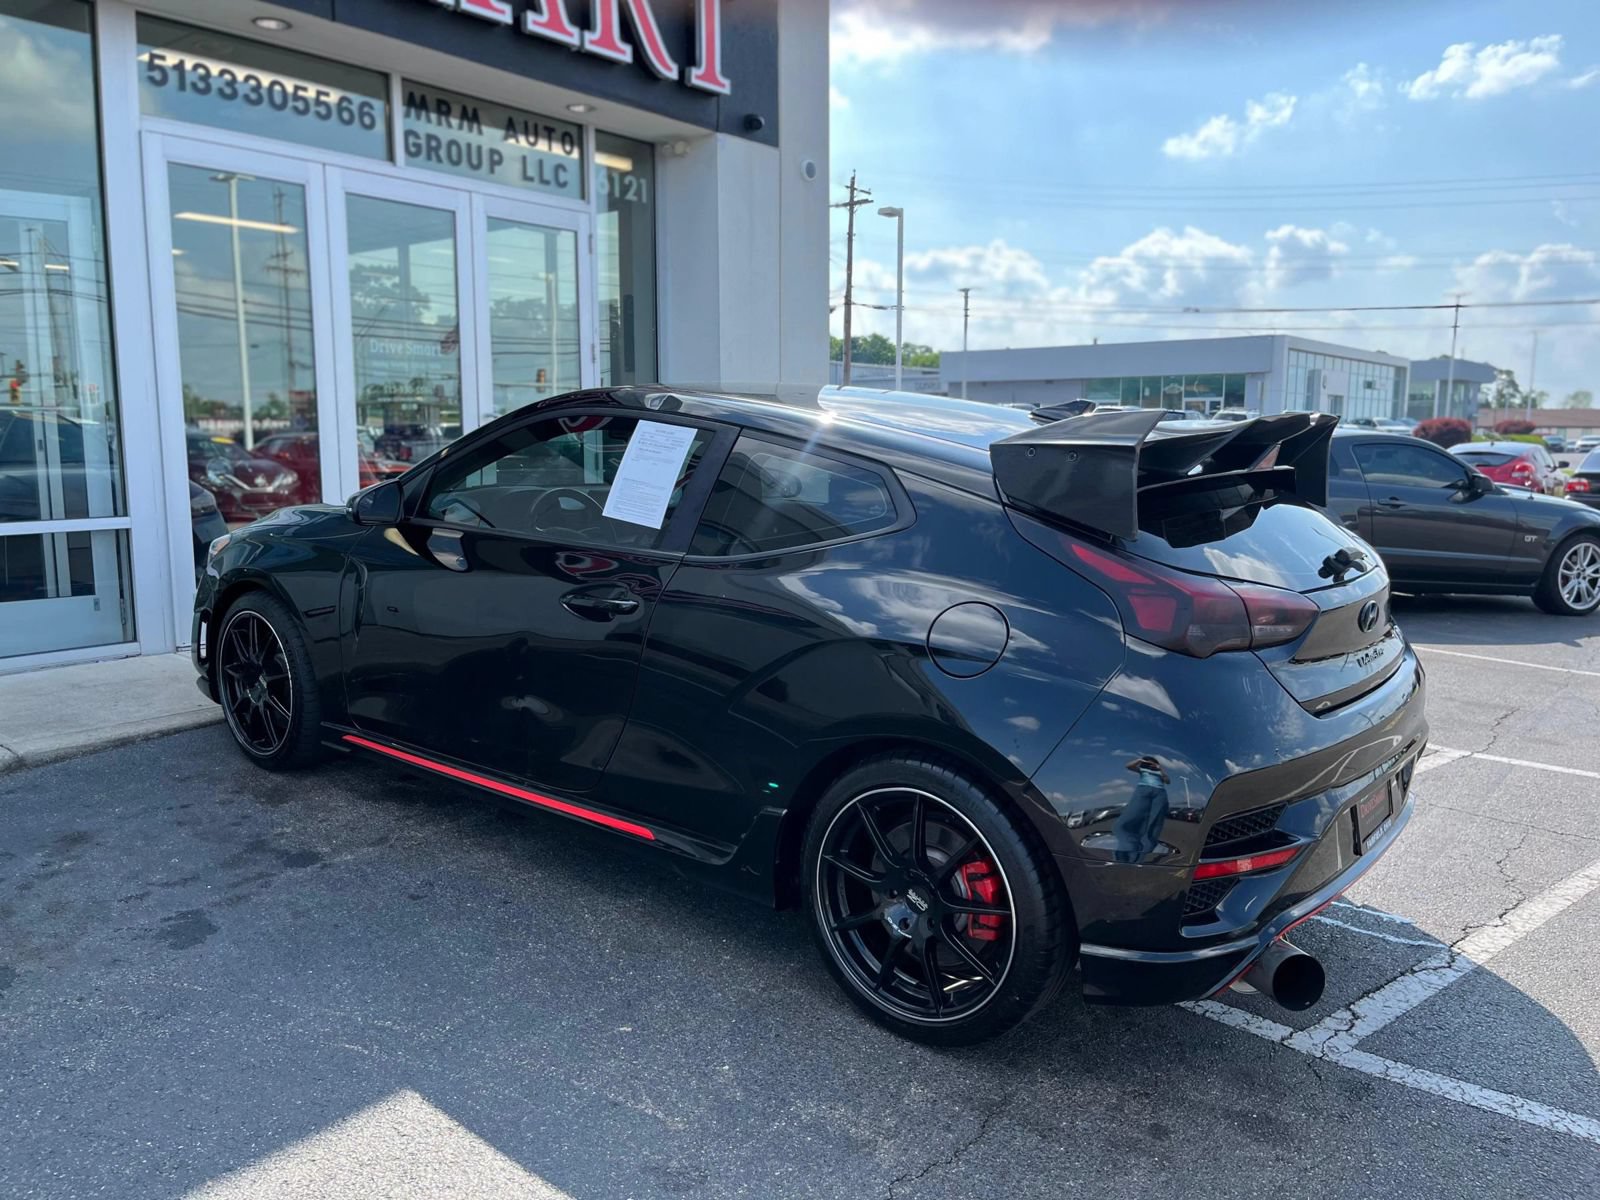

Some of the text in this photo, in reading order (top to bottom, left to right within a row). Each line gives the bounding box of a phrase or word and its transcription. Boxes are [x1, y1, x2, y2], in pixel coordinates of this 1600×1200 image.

[147, 53, 377, 131] 5133305566
[403, 91, 576, 156] MRM AUTO
[403, 129, 568, 189] GROUP LLC
